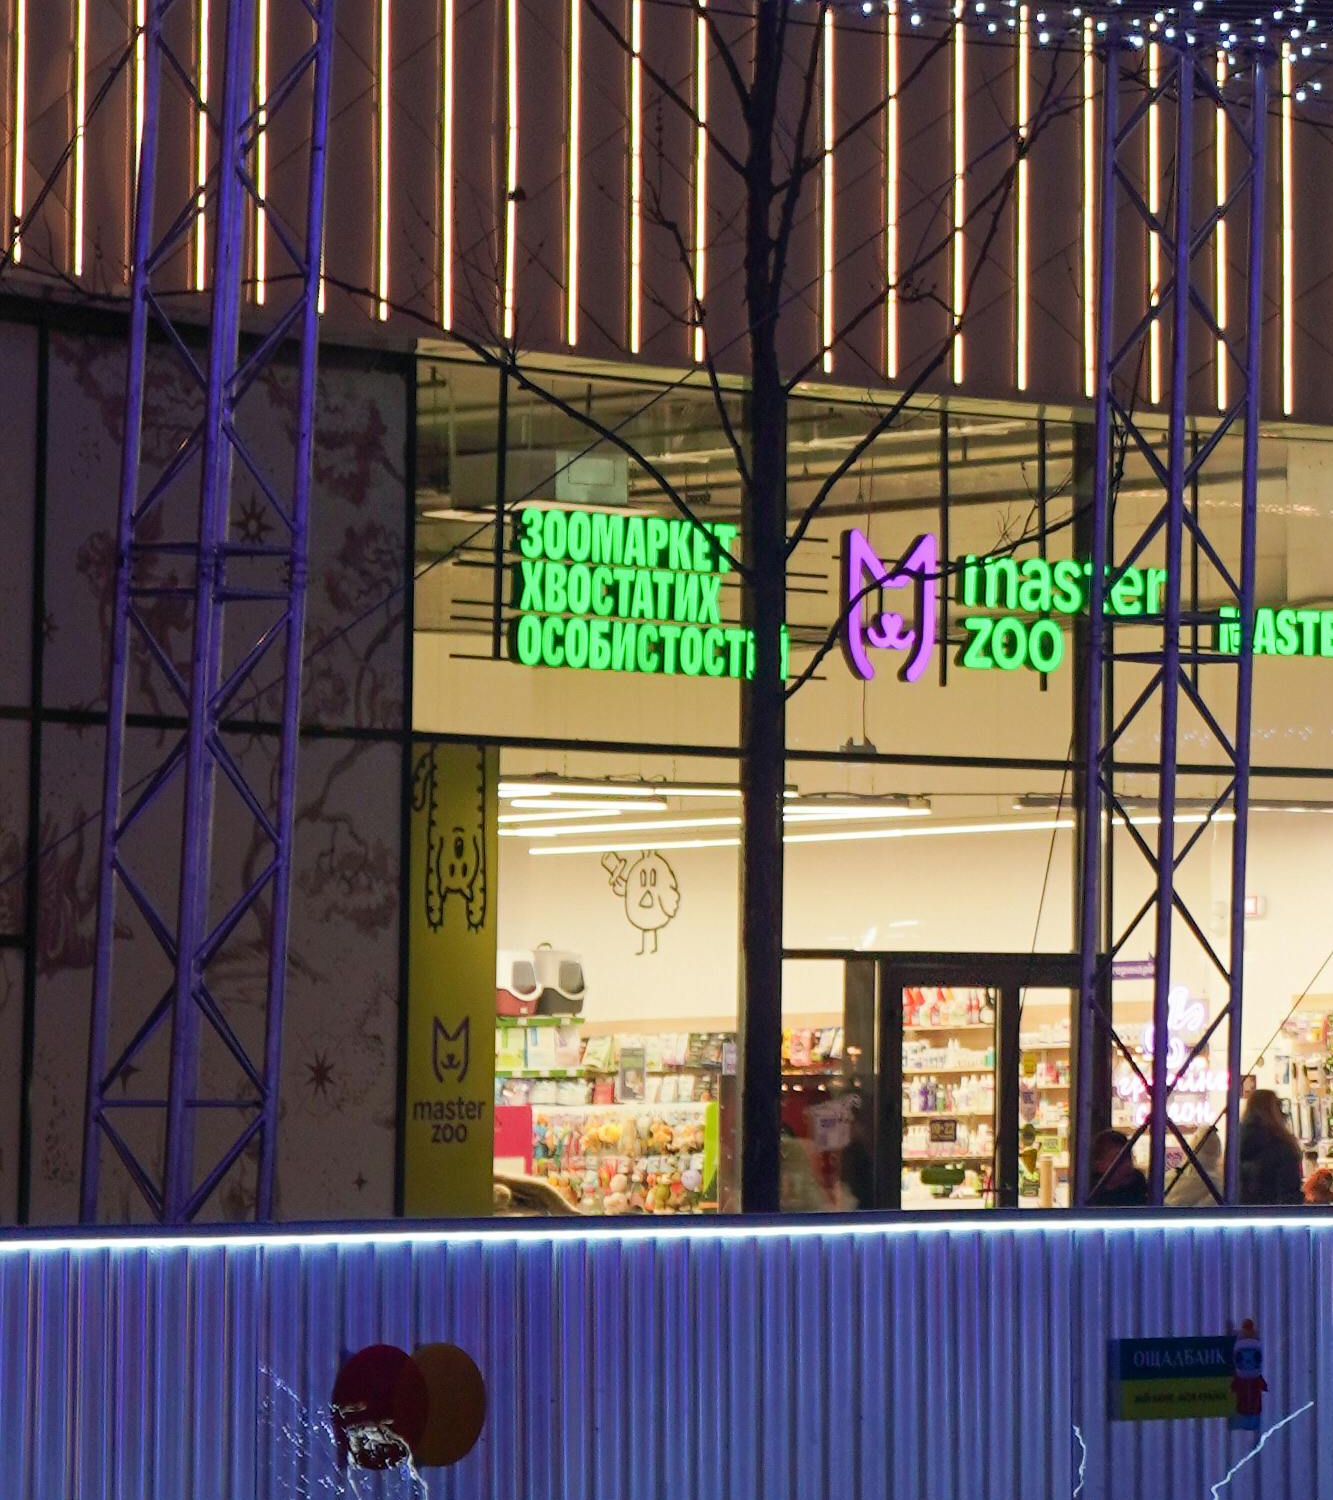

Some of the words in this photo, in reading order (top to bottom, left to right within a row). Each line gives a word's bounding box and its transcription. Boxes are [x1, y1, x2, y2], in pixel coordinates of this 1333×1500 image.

[520, 507, 738, 574] ЗООМАРКЕТ
[520, 559, 722, 625] ХВОСТАТИХ
[517, 613, 789, 680] ОСОБИСТОСТ
[962, 617, 1064, 673] zoo
[413, 1096, 485, 1121] master
[431, 1123, 468, 1143] zoo
[1134, 1349, 1227, 1369] ОЩАДБАНК
